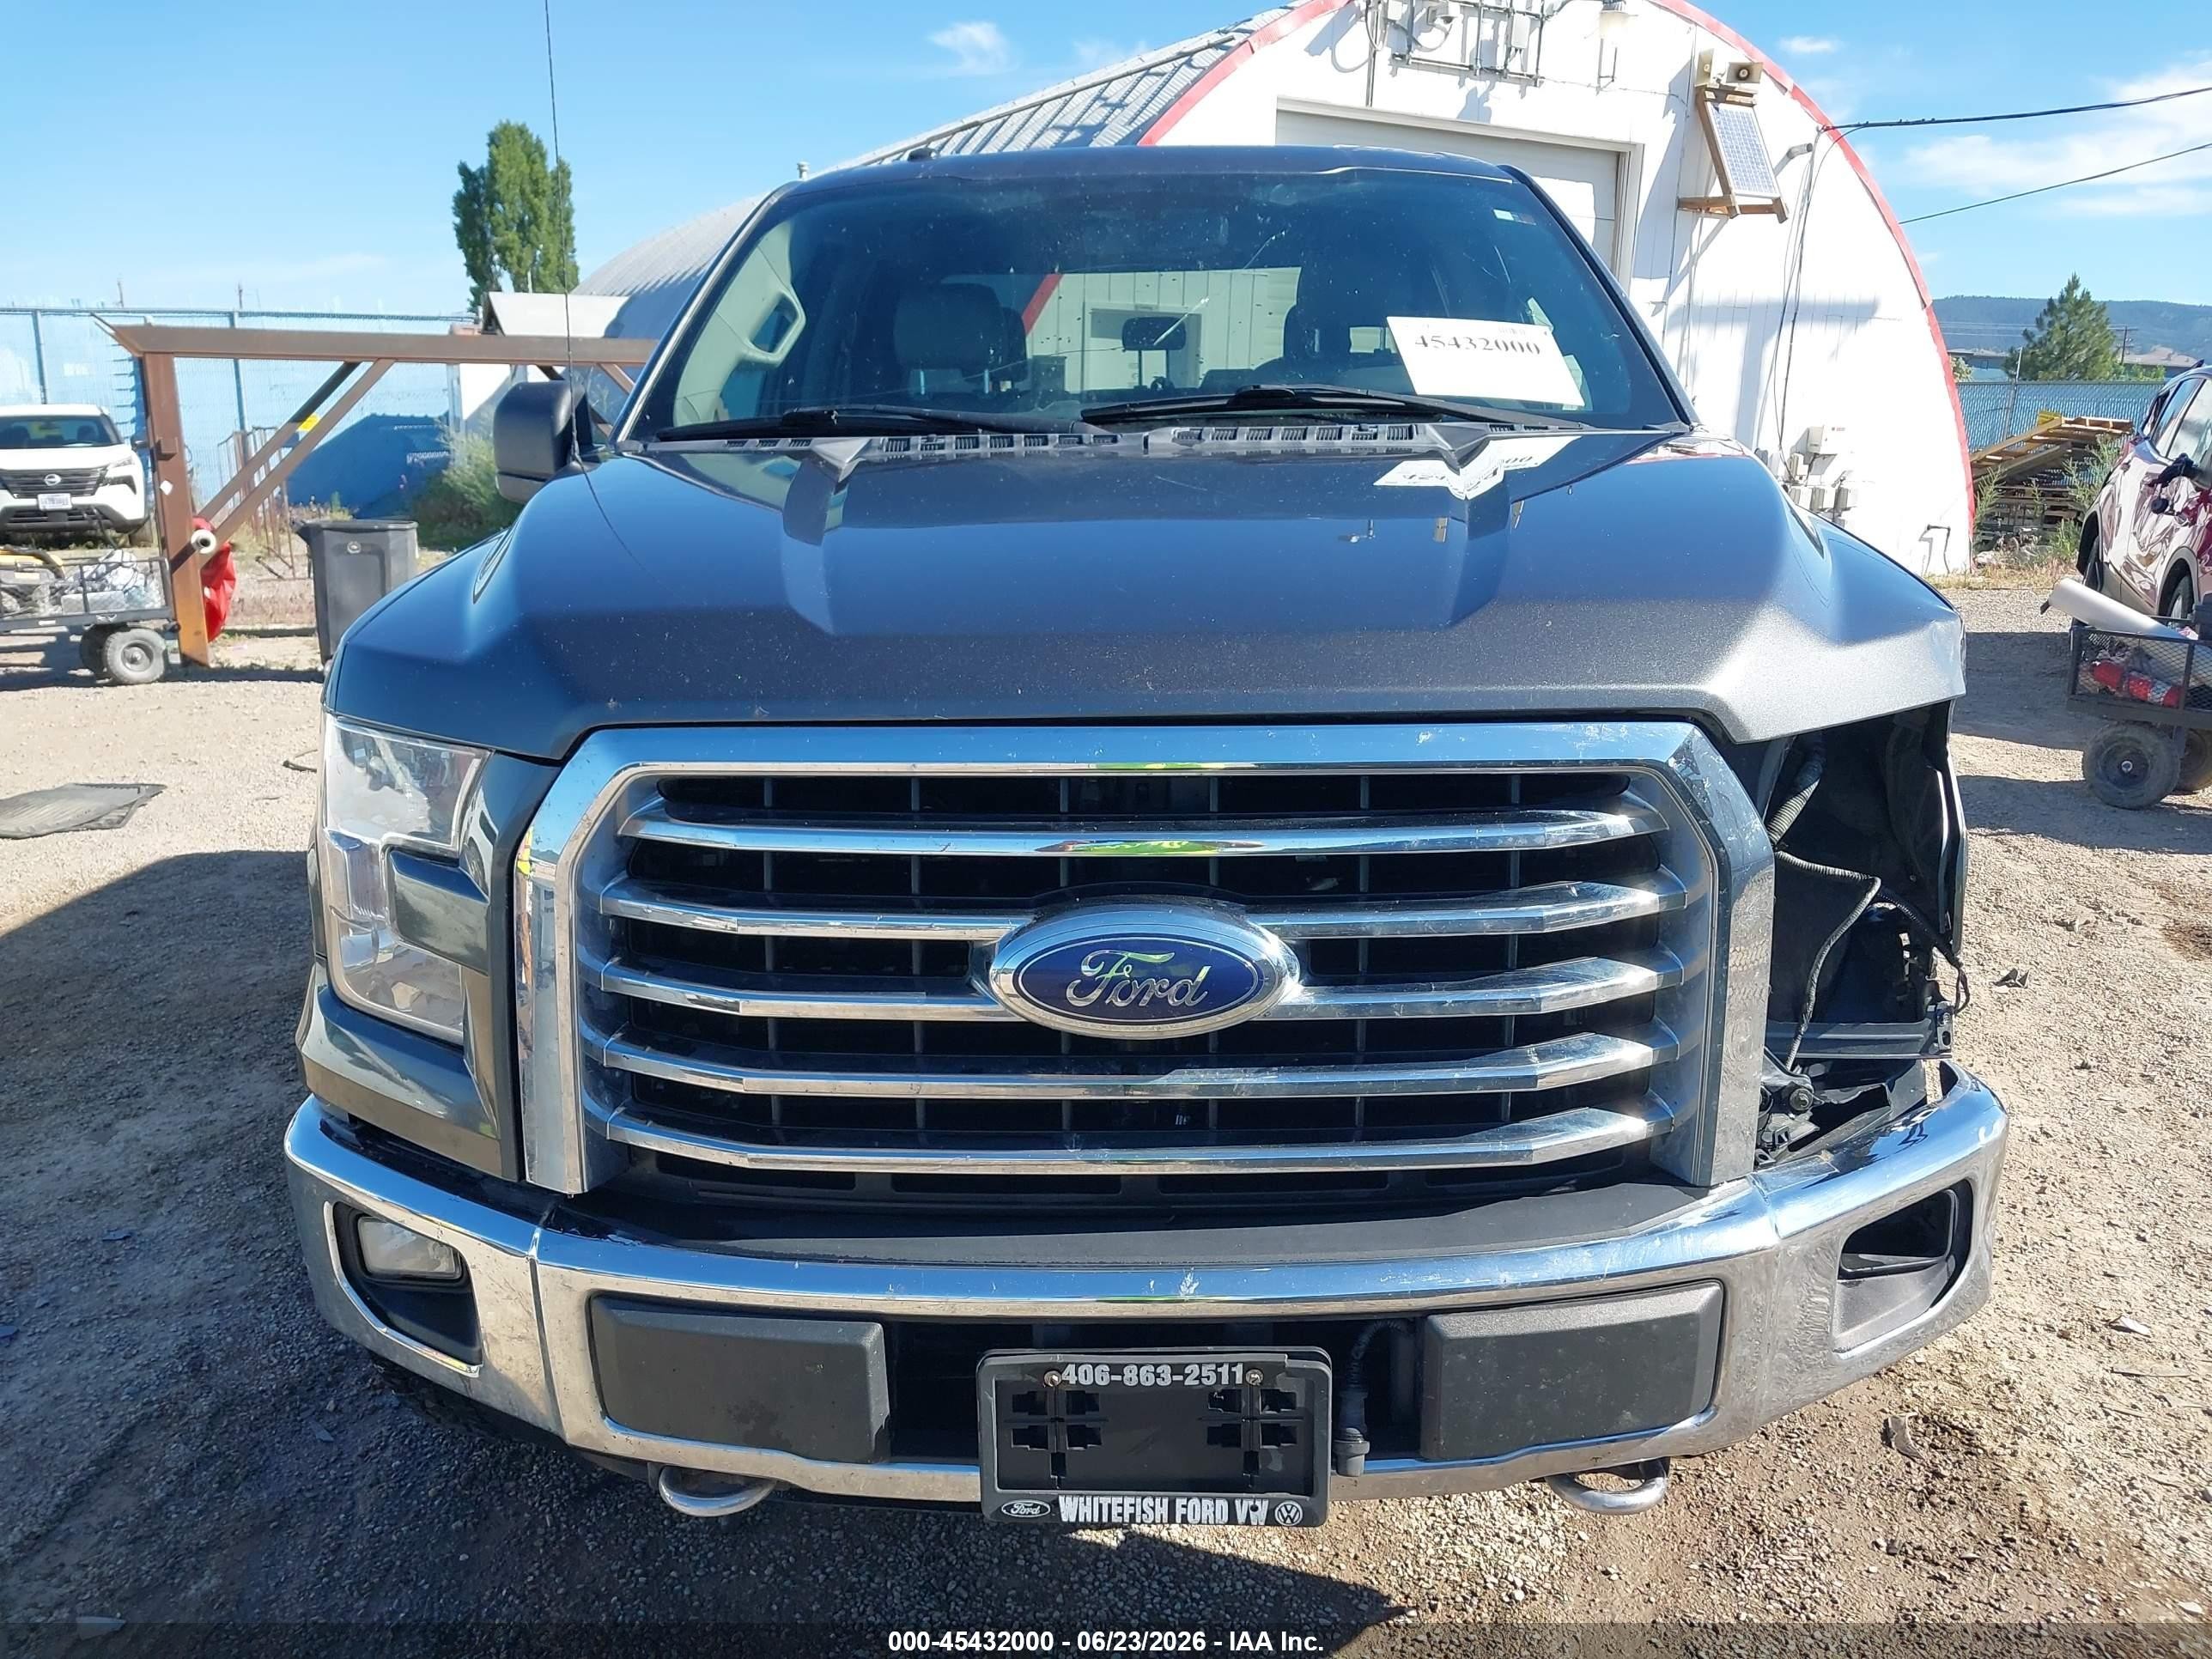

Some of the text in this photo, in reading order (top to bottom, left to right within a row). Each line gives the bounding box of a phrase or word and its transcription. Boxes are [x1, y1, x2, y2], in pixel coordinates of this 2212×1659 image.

[1414, 335, 1540, 355] 45432000
[1066, 949, 1212, 1007] Ford
[1061, 1363, 1243, 1386] 406-863-2511
[1011, 1503, 1041, 1516] Ford
[1058, 1495, 1269, 1525] WHITEFISH FORD VW
